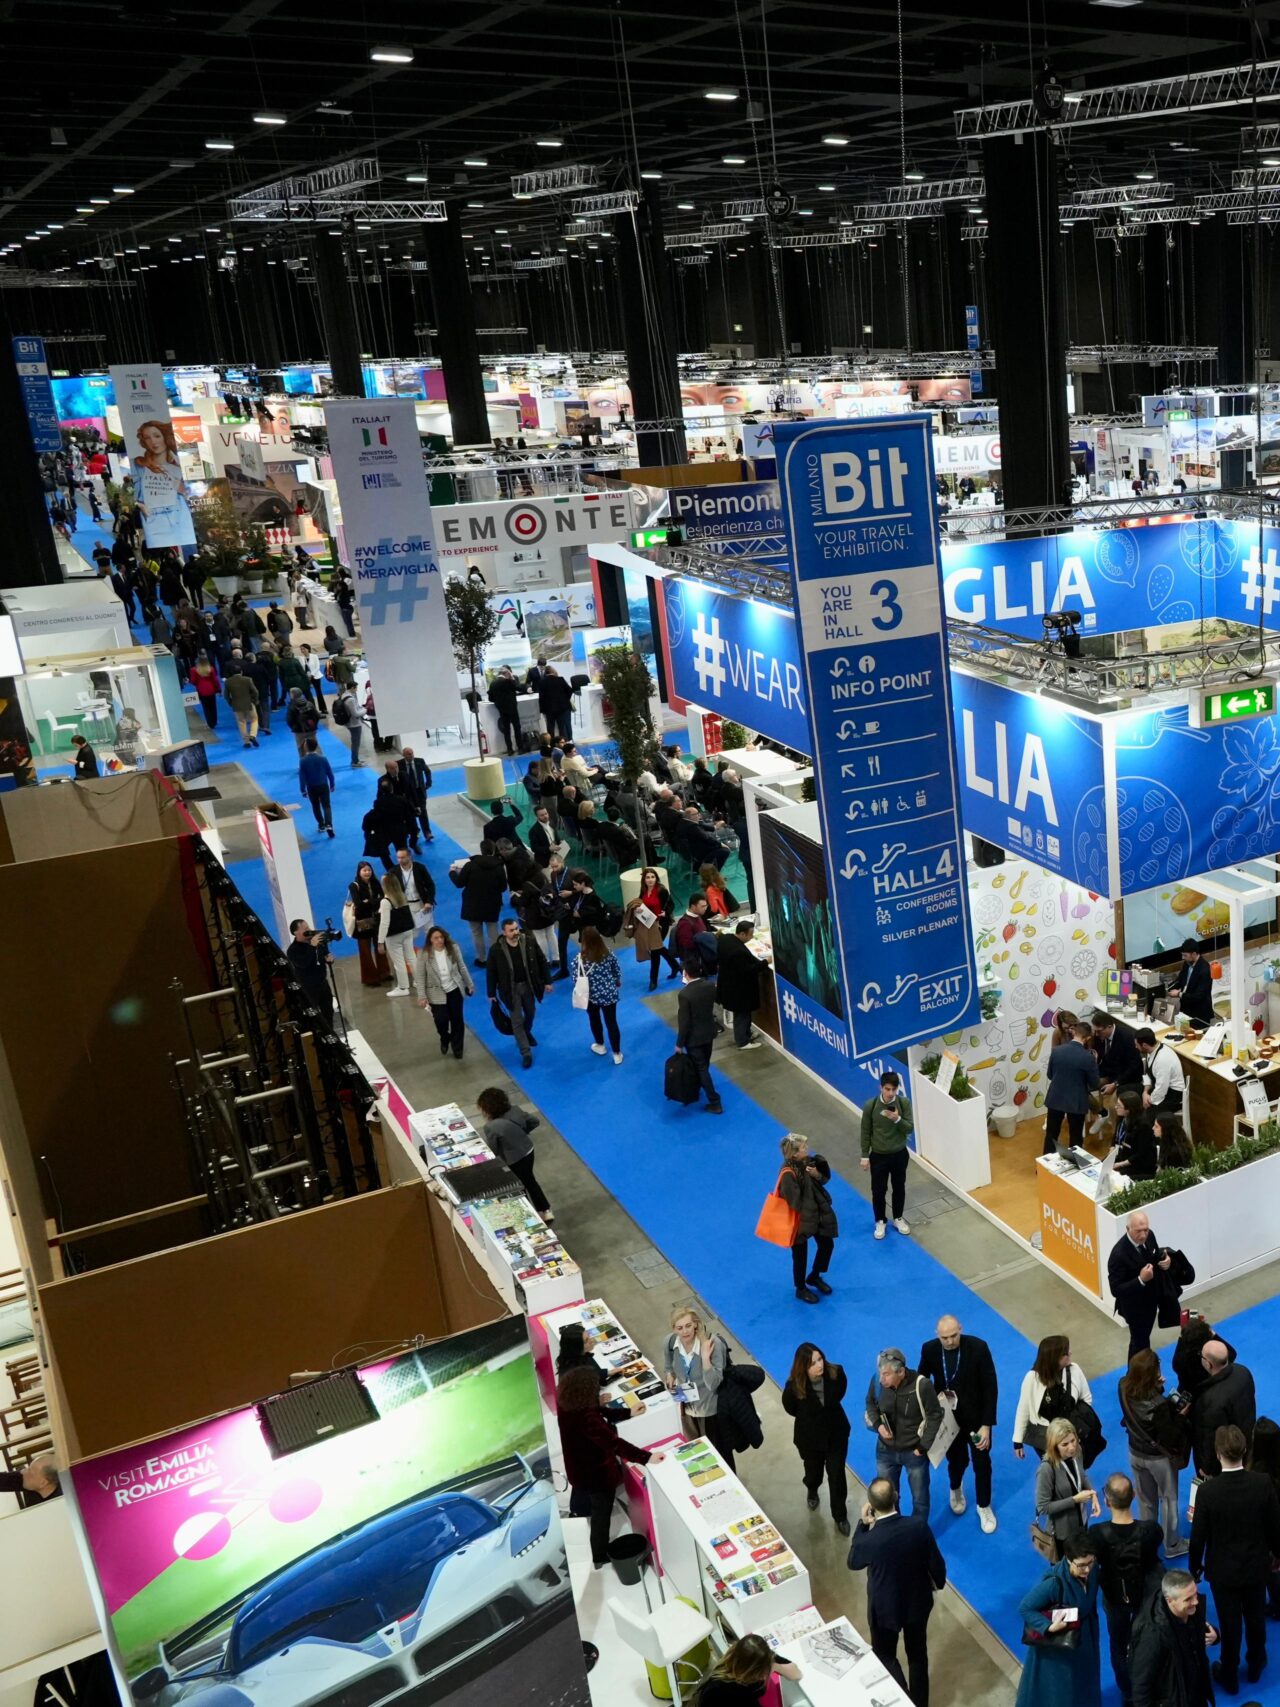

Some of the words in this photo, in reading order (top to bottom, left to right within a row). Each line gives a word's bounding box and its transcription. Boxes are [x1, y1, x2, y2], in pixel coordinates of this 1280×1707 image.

[18, 341, 39, 353] Bit
[31, 364, 39, 374] 3
[352, 415, 391, 425] ITALIA.IT
[267, 462, 296, 474] EZIA
[806, 454, 823, 516] MILANO
[820, 447, 908, 514] Bit
[604, 492, 624, 500] ITALY
[675, 494, 781, 517] Piemont
[442, 503, 627, 546] EMONTE
[814, 529, 857, 545] YOUR
[861, 523, 914, 539] TRAVEL
[354, 541, 432, 558] #WELCOME
[454, 545, 499, 555] EXPERIENCE
[823, 539, 909, 560] EXHIBITION.
[356, 558, 376, 568] TO
[357, 562, 438, 580] MERAVIGLIA
[820, 585, 852, 600] YOU
[943, 555, 1097, 625] GLIA
[822, 598, 853, 613] ARE
[869, 579, 903, 631] 3
[23, 619, 49, 628] CENTRO
[49, 615, 86, 625] CONGRESSI
[823, 614, 838, 627] IN
[825, 625, 864, 640] HALL
[691, 612, 806, 716] #WEAR
[830, 680, 875, 700] INFO
[879, 670, 932, 693] POINT
[962, 705, 1060, 827] LIA
[873, 865, 937, 896] HALL
[935, 848, 955, 878] 4
[895, 887, 957, 912] CONFERENCE
[925, 898, 958, 914] ROOMS
[881, 927, 916, 943] SILVER
[918, 915, 959, 935] PLENARY
[919, 974, 964, 1003] EXIT
[920, 993, 961, 1012] BALCONY
[1043, 1202, 1094, 1254] PUGLIA
[1043, 1220, 1059, 1236] FOR
[1061, 1233, 1096, 1264] FOODIES
[98, 1465, 146, 1491] VISIT
[145, 1443, 215, 1477] EMILIA
[114, 1459, 219, 1508] ROMAGNA
